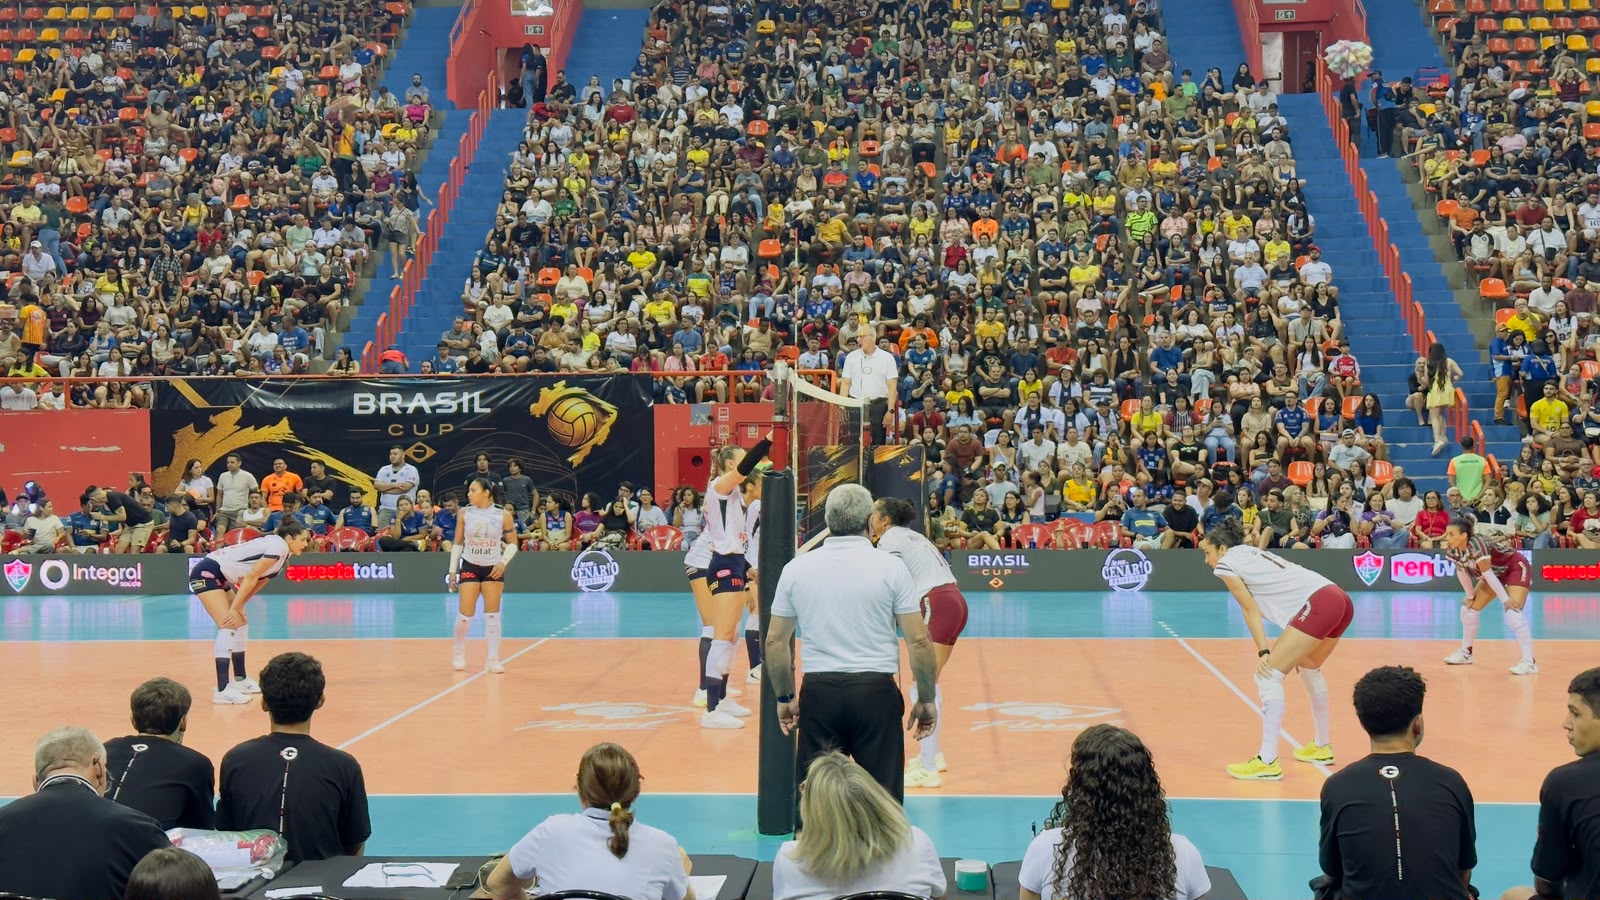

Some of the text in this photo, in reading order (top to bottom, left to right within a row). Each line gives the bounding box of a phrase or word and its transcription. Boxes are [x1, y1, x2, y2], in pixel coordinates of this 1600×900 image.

[353, 391, 491, 415] BRASIL
[387, 423, 454, 436] CUP
[473, 522, 490, 538] 21
[968, 554, 1030, 567] BRASIL
[72, 562, 143, 586] Integral
[981, 568, 1012, 576] CUP
